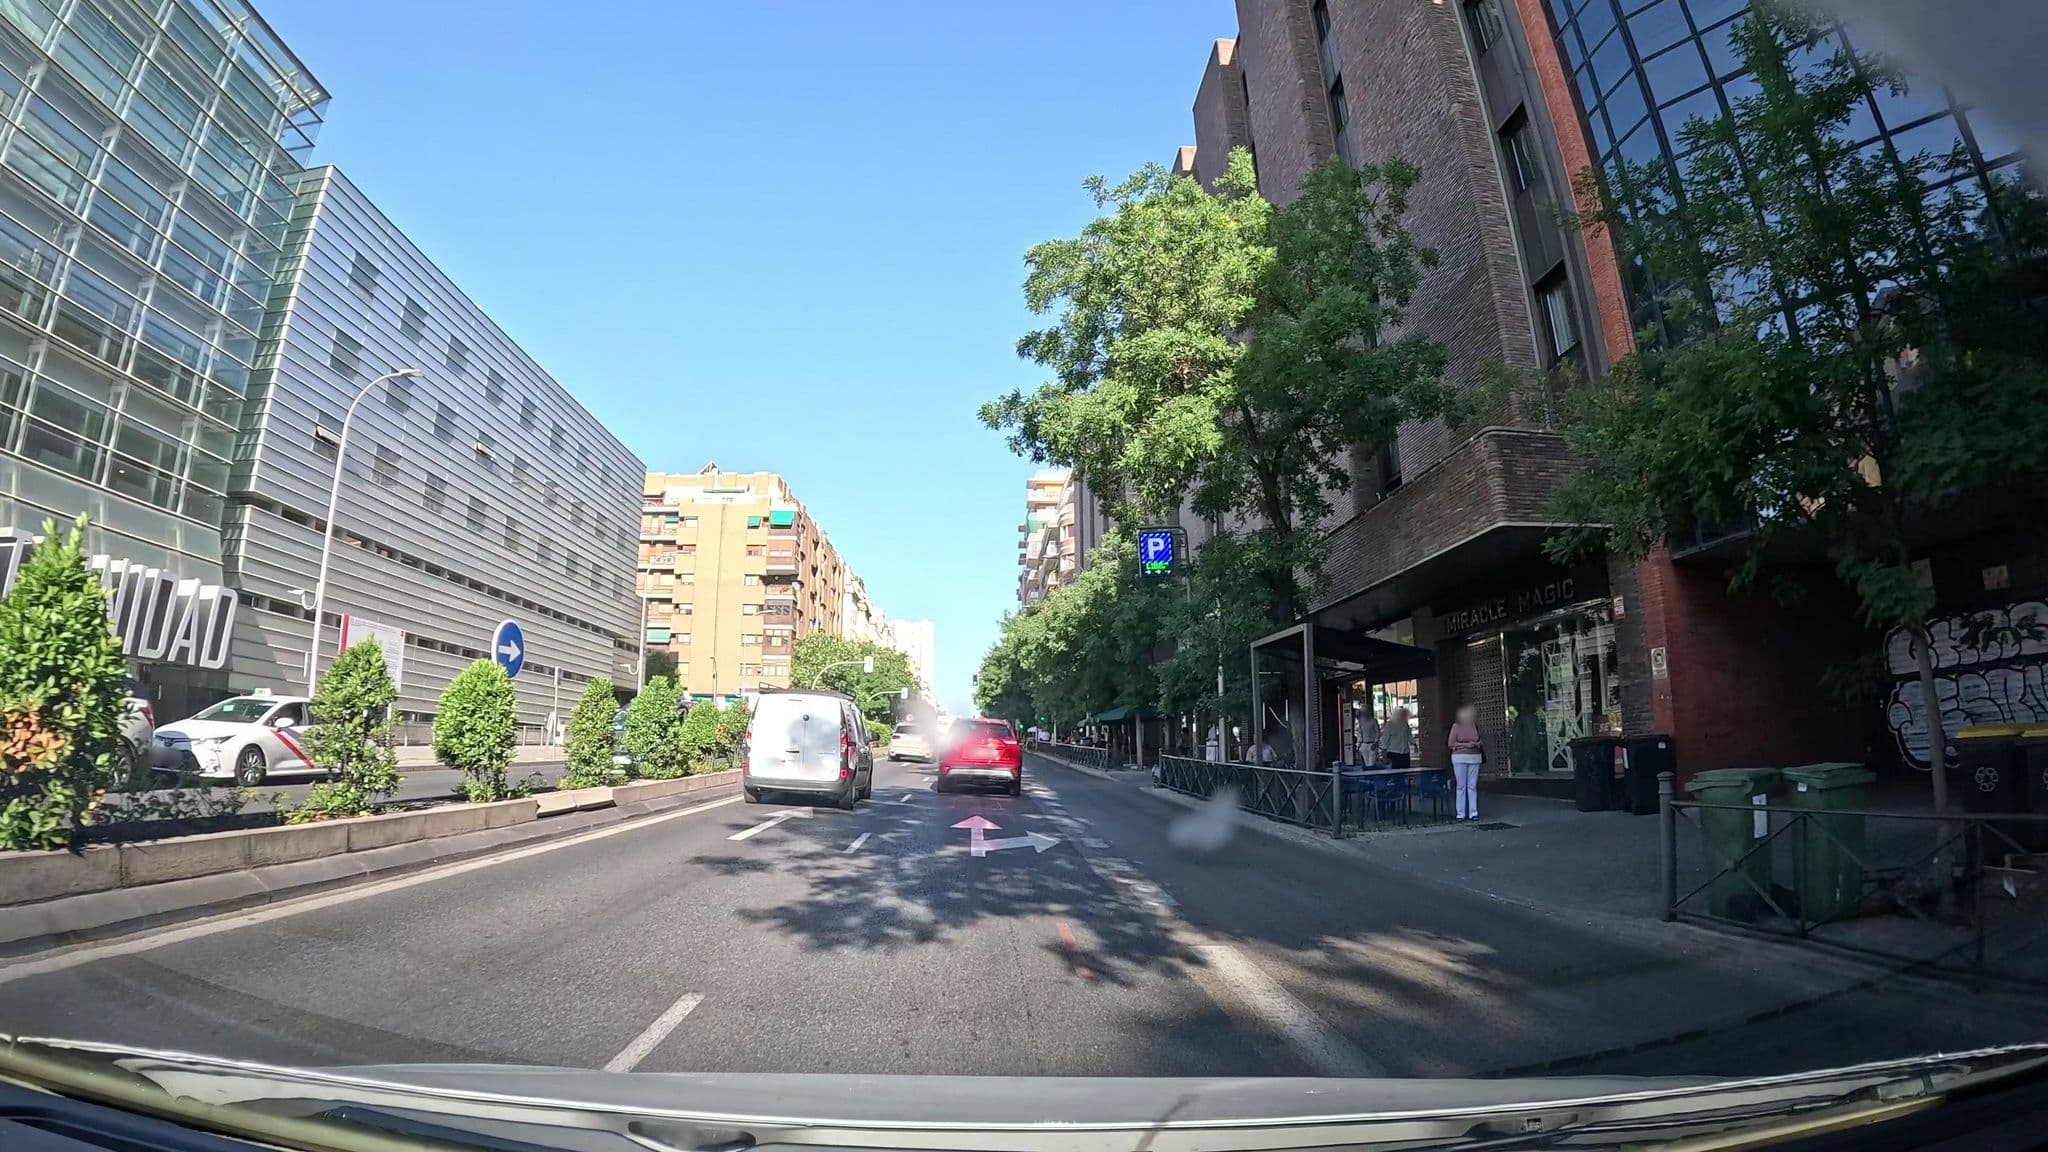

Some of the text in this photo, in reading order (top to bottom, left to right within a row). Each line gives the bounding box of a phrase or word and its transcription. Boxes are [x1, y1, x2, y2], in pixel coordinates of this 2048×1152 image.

[1147, 537, 1165, 560] P
[1447, 599, 1508, 633] MIRACLE
[1519, 577, 1575, 613] MAGIC
